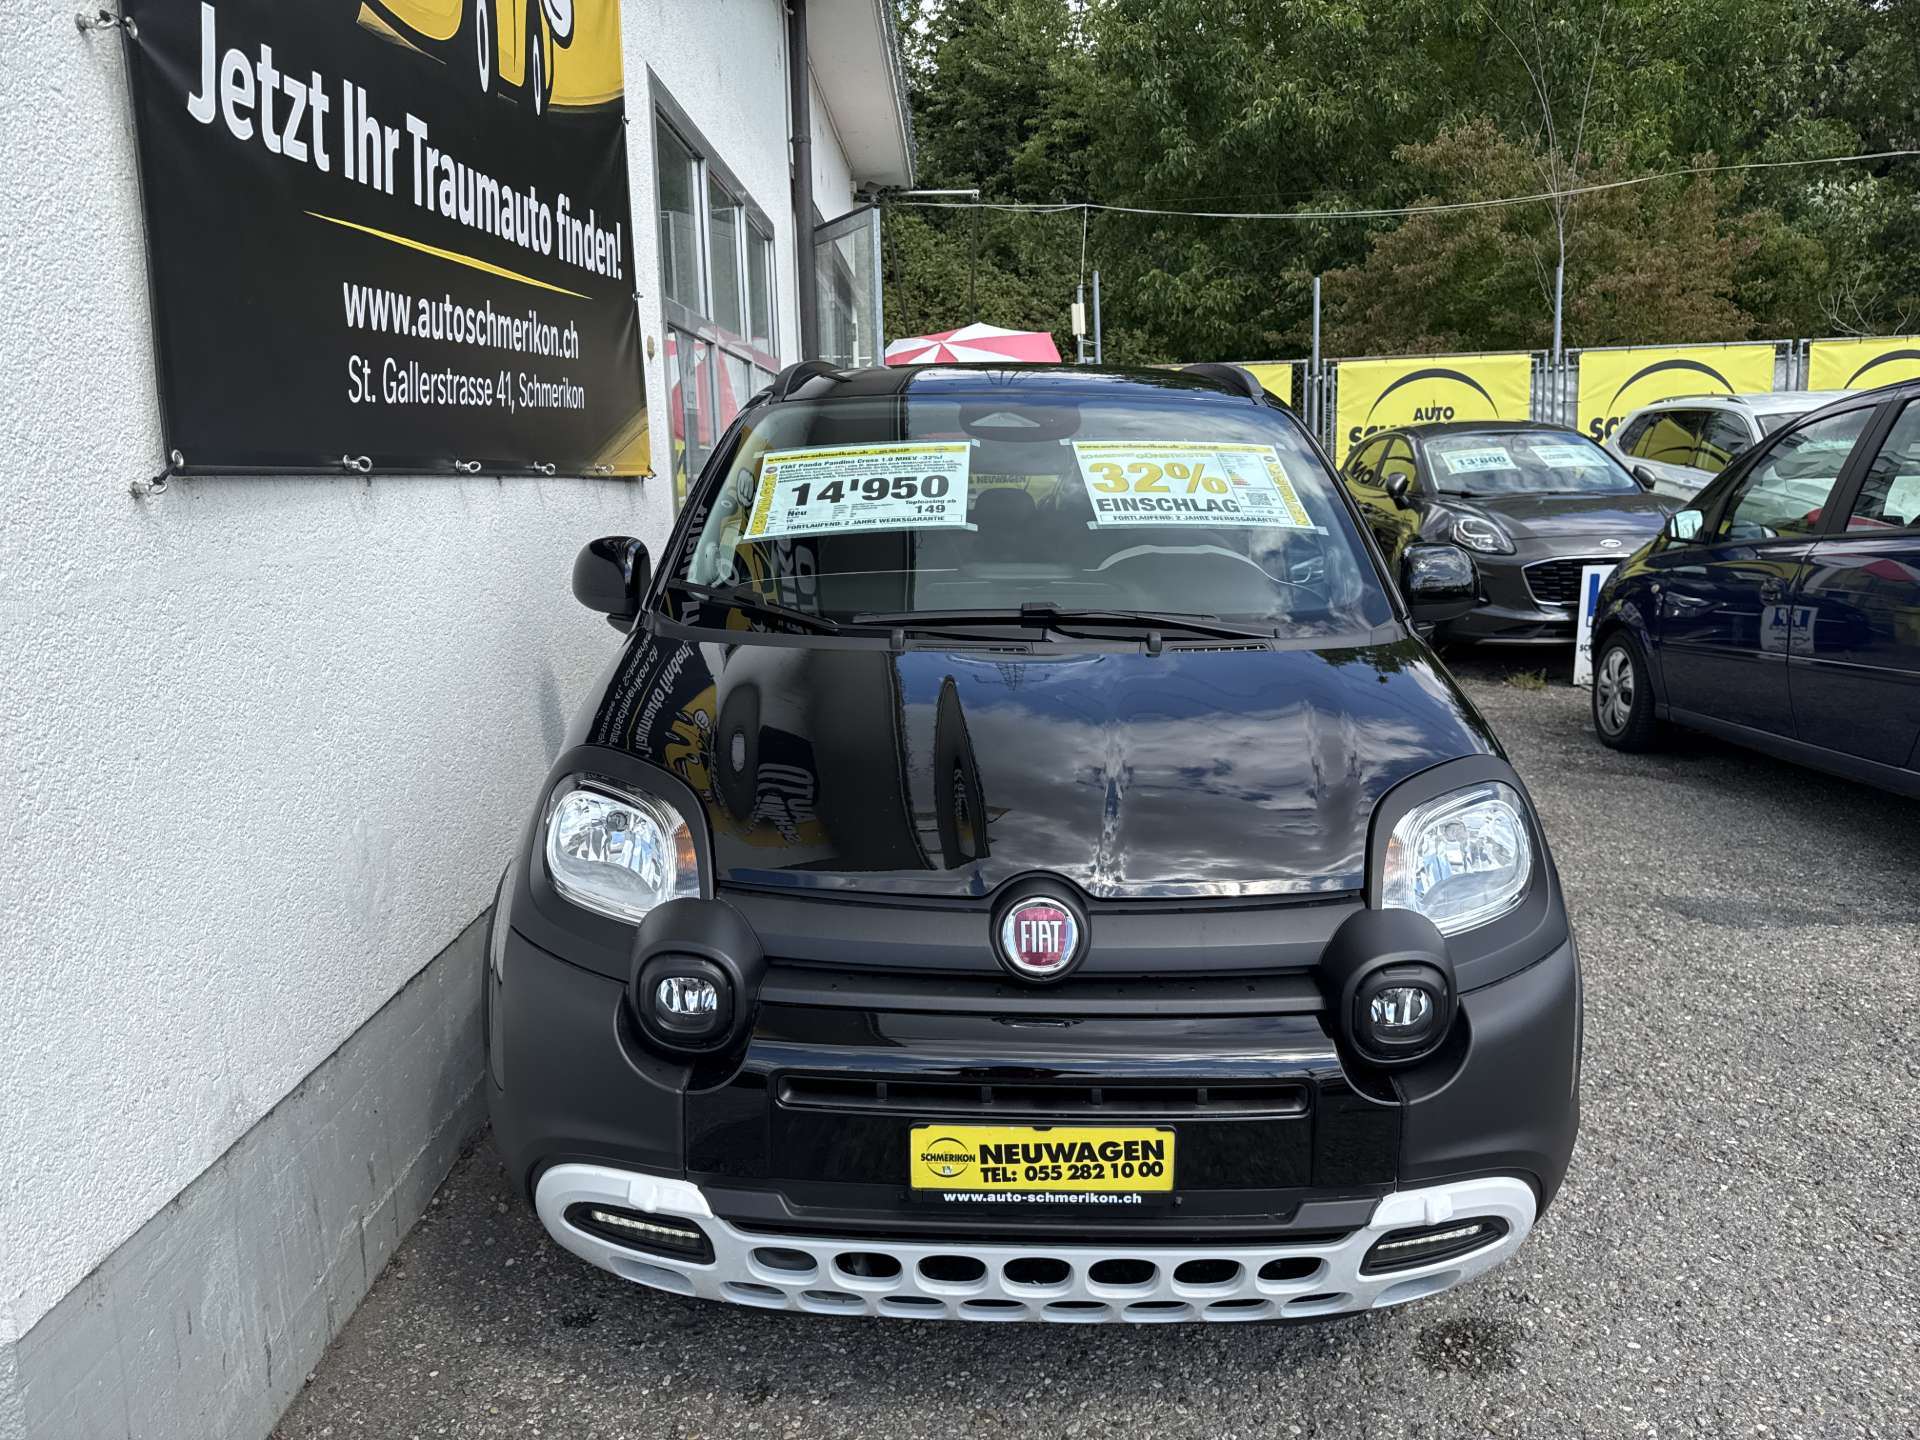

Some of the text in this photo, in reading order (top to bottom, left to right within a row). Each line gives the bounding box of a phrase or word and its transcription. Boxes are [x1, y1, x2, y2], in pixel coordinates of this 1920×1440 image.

[187, 1, 623, 281] Jetzt Ihr Traumauto finden!
[343, 282, 579, 360] www.autoschmerikon.ch
[348, 355, 585, 415] St. Gallerstrasse 41, Schmerikon
[1413, 406, 1455, 421] AUTO
[1088, 462, 1229, 494] 32%
[791, 474, 950, 507] 14'950
[914, 504, 946, 514] 149
[1096, 497, 1241, 513] EINSCHLAG
[879, 516, 945, 524] WERKSGARANTIE
[1020, 920, 1063, 953] FIAT
[920, 1153, 976, 1163] SCHMERIKON
[979, 1139, 1165, 1165] NEUWAGEN
[980, 1161, 1164, 1183] TEL: 055 282 10 00
[943, 1191, 1142, 1204] www.auto-schmerikon.ch
